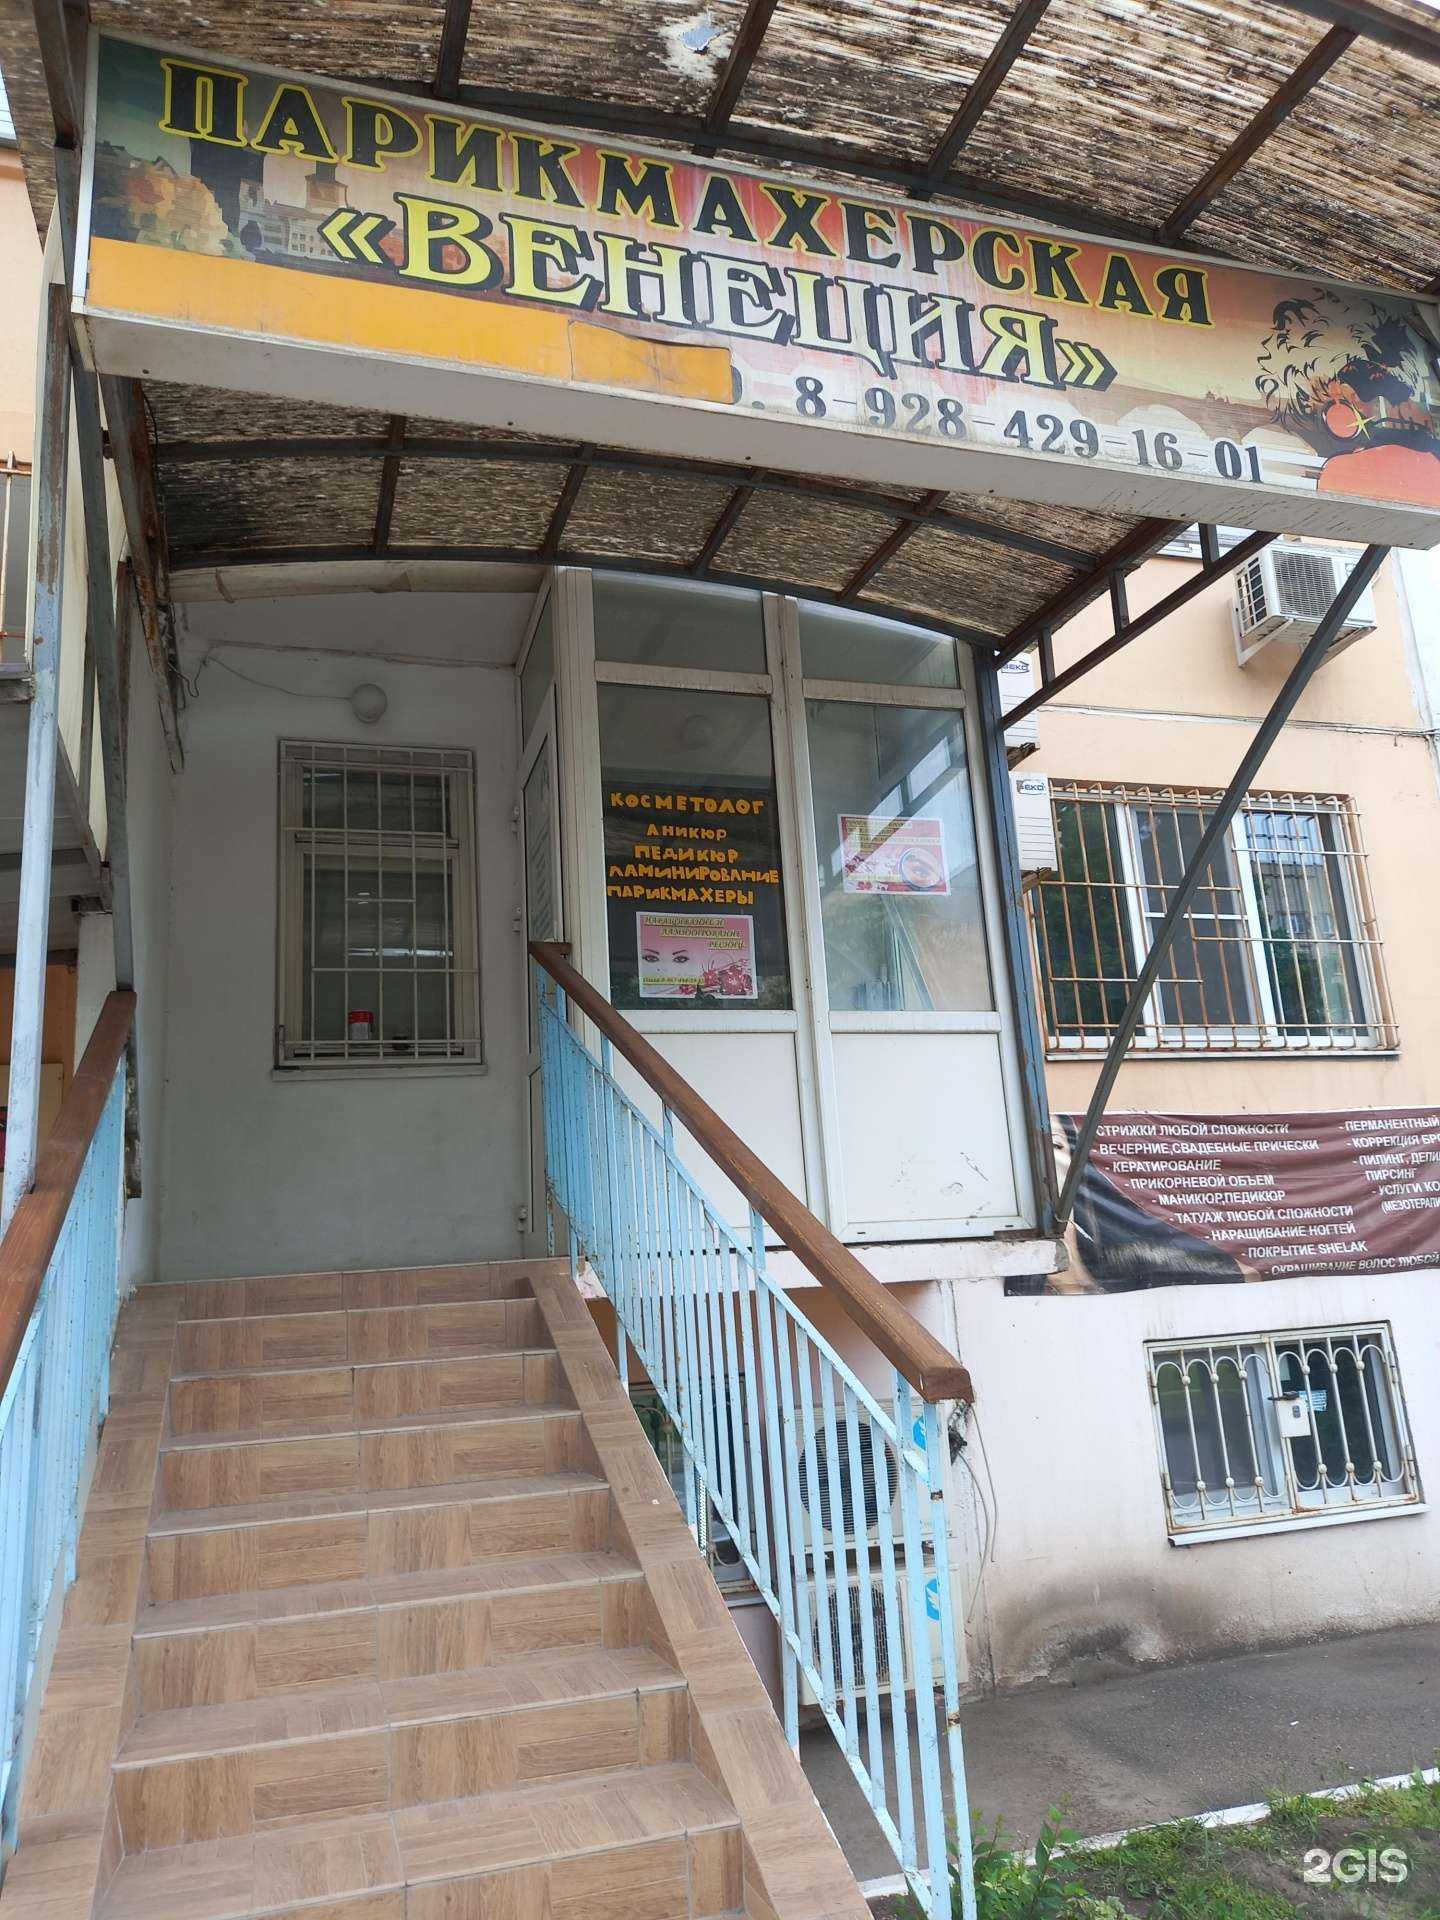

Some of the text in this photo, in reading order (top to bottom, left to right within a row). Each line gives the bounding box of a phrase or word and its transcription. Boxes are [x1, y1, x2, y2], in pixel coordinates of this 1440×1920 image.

[159, 58, 1213, 329] ПАРИКМАХЕРСКАЯ
[318, 192, 1118, 392] «ВЕНЕЦИЯ»
[610, 792, 764, 814] КОСМЕТОЛОГ
[646, 823, 727, 841] АНИКЮР
[634, 844, 738, 863] ПЕДИКЮР
[609, 864, 780, 883] ЛАМИНИРОВАНИЕ
[607, 886, 754, 904] ПАРИКМАХЕРЫ
[1096, 1123, 1290, 1137] СТРИЖКИ ЛЮБОЙ СЛОЖНОСТИ
[1345, 1115, 1440, 1131] ПЕРМАНЕНТНЫЙ
[1254, 1139, 1320, 1151] ПРИЧЕСКИ
[1352, 1135, 1419, 1148] КОРРЕКЦИЯ
[1113, 1159, 1221, 1173] КЕРАТИРОВАНИЕ
[1365, 1168, 1417, 1180] ПИРСИНГ
[1131, 1174, 1275, 1190] ПРИКОРНЕВОЙ ОБЪЕМ
[1379, 1183, 1422, 1196] УСЛУГИ
[1174, 1205, 1354, 1225] ТАТУАЖ ЛЮБОЙ СЛОЖНОСТИ
[1212, 1220, 1356, 1242] НАРАЩИВАНИЕ НОГТЕЙ
[1248, 1240, 1368, 1258] ПОКРЫТИЕ SHELAK
[1358, 1257, 1396, 1270] ВОЛОС
